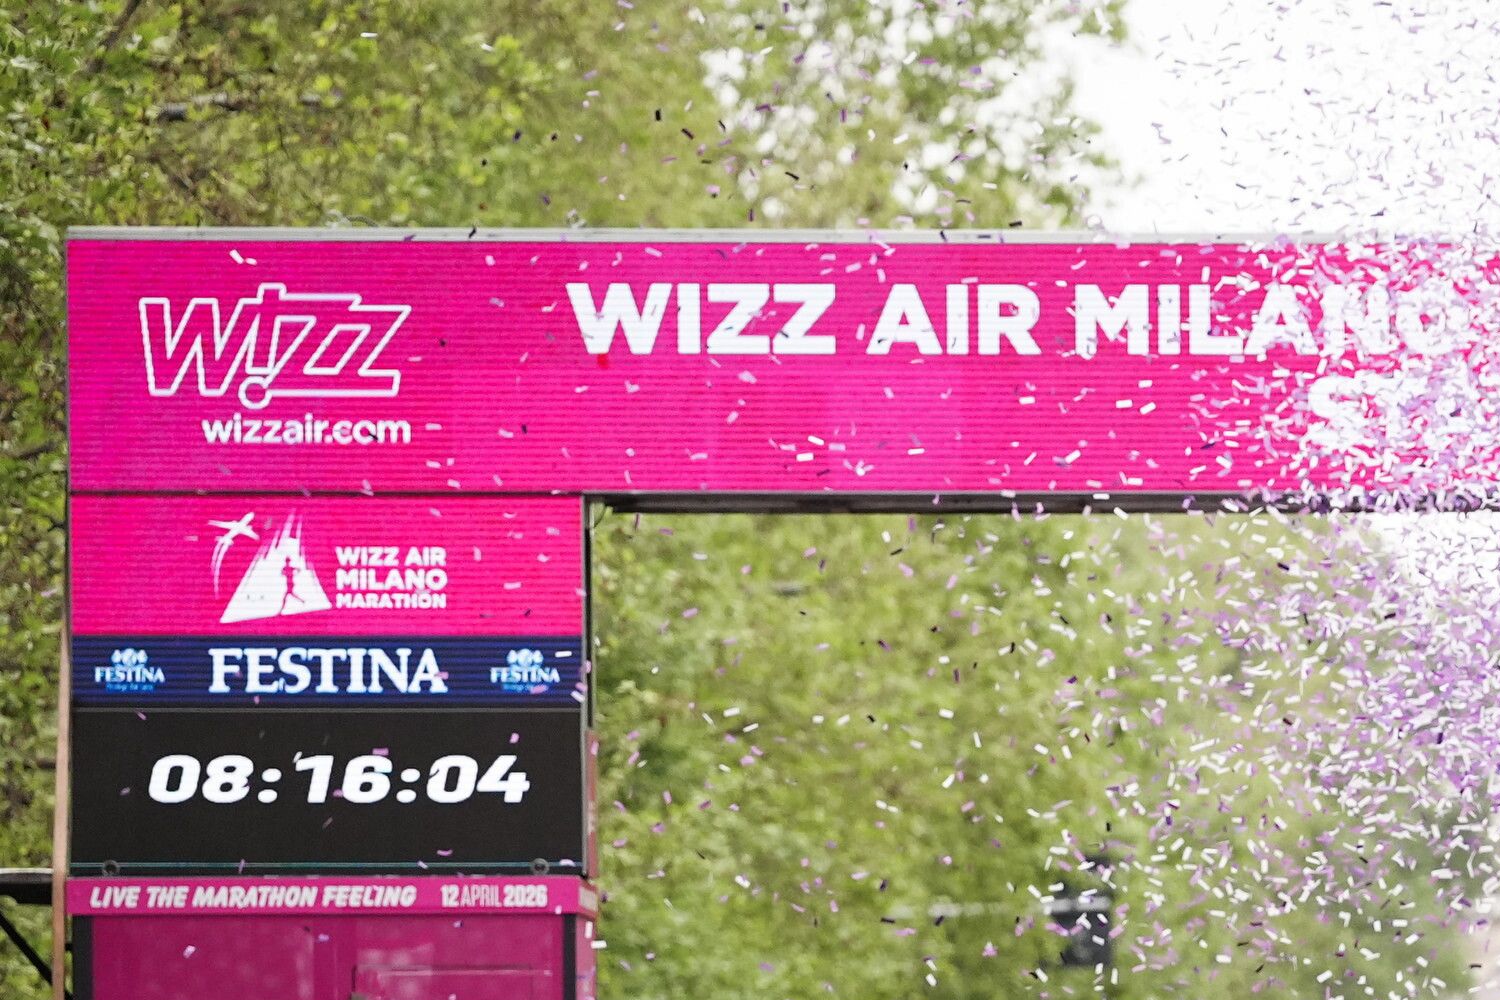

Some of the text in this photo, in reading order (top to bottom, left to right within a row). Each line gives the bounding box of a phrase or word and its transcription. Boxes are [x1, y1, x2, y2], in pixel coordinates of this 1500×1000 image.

[566, 282, 837, 356] WIZZ
[866, 283, 1041, 356] AIR
[202, 413, 412, 445] wizzair.com
[335, 545, 447, 567] WIZZ AIR
[335, 568, 448, 591] MILANO
[335, 592, 447, 609] MARATHON
[95, 665, 165, 683] FESTINA
[208, 648, 449, 694] FESTINA
[490, 666, 561, 683] FESTINA
[148, 754, 530, 804] 08:16:04
[89, 885, 417, 909] LIVE THE MARATHON FEELING
[440, 884, 548, 908] 12 APRIL 2026
